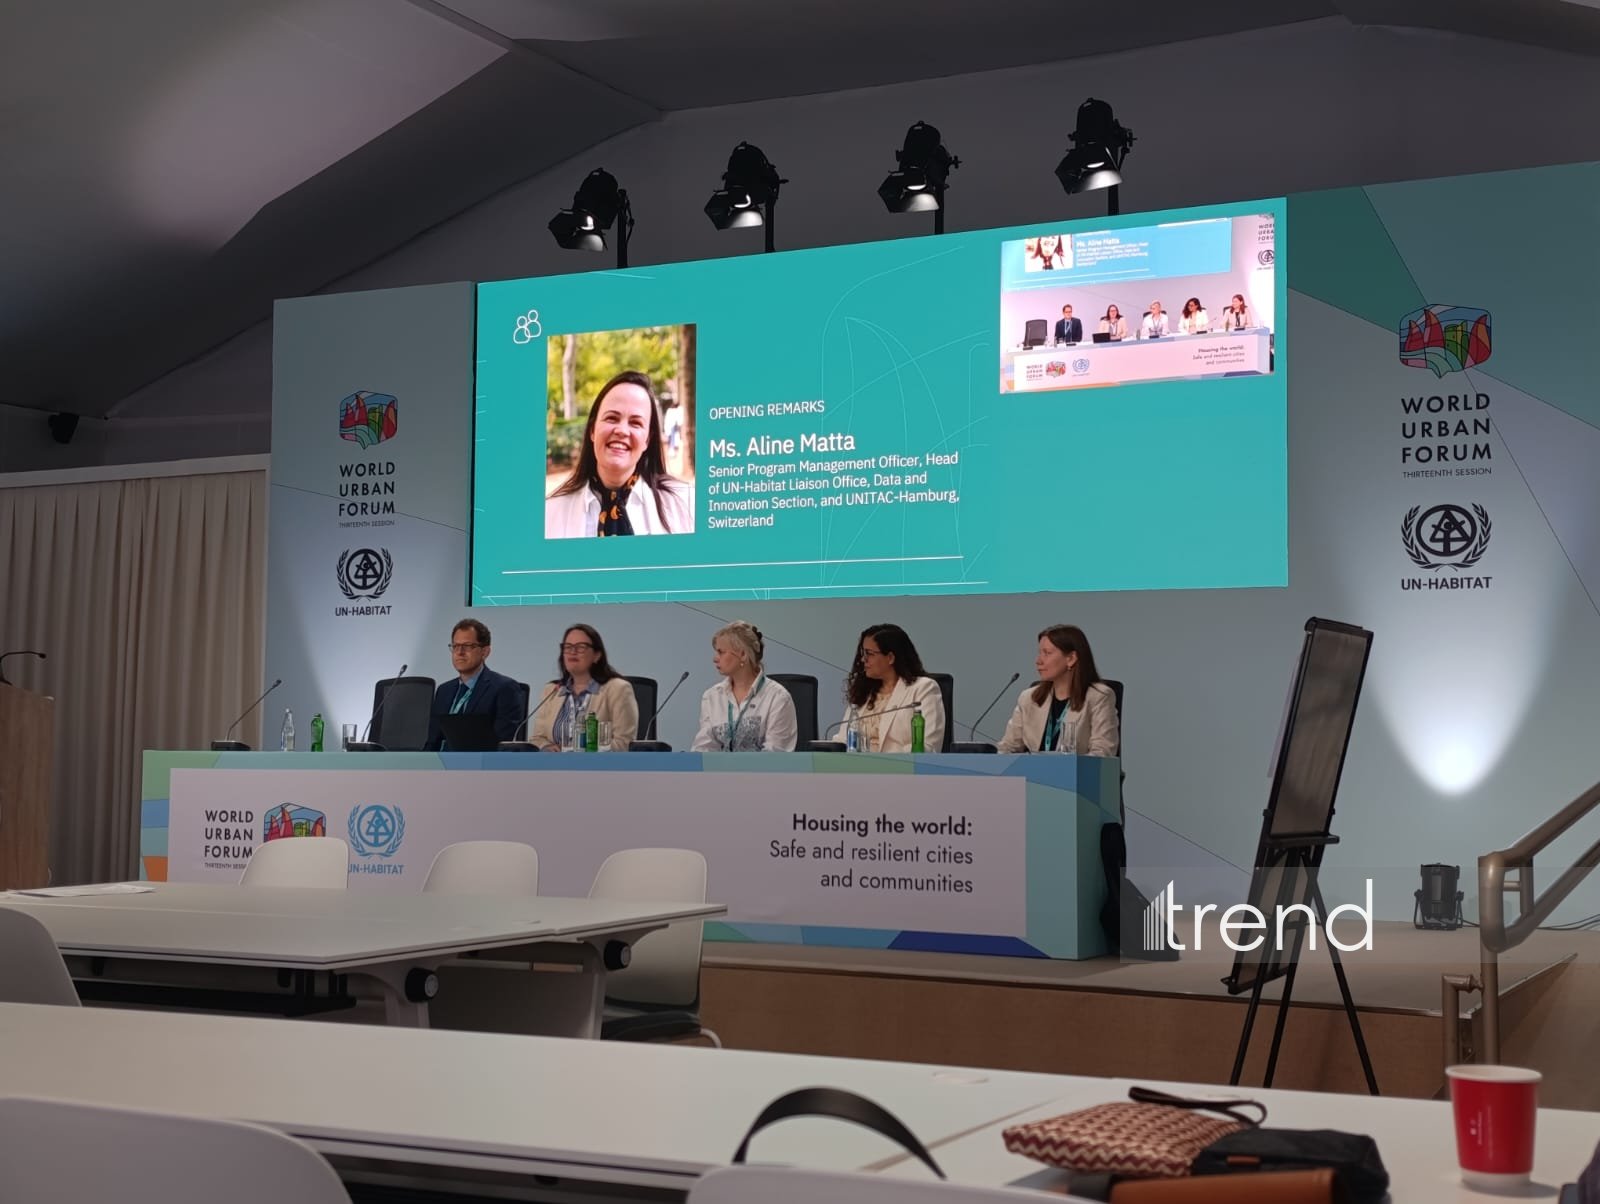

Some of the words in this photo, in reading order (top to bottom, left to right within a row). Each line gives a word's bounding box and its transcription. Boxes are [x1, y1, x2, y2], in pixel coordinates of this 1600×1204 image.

[709, 404, 765, 420] OPENING
[767, 400, 825, 416] REMARKS
[1401, 393, 1490, 414] WORLD
[1402, 418, 1490, 439] URBAN
[709, 439, 741, 459] Ms.
[746, 435, 795, 456] Aline
[799, 432, 856, 453] Matta
[1402, 443, 1492, 464] FORUM
[339, 462, 396, 478] WORLD
[708, 465, 745, 478] Senior
[747, 462, 796, 478] Program
[799, 457, 876, 474] Management
[878, 454, 923, 469] Officer,
[926, 451, 959, 466] Head
[1402, 469, 1453, 479] THIRTEENTH
[1455, 467, 1492, 477] SESSION
[339, 481, 395, 498] URBAN
[708, 482, 721, 495] of
[722, 480, 786, 494] UN-Habitat
[789, 477, 829, 491] Liaison
[832, 474, 871, 489] Office,
[873, 473, 902, 486] Data
[904, 471, 928, 485] and
[338, 501, 395, 517] FORUM
[708, 497, 769, 512] Innovation
[771, 495, 818, 510] Section,
[820, 493, 843, 506] and
[708, 514, 774, 528] Switzerland
[1401, 577, 1493, 590] UN-HABITAT
[335, 605, 393, 617] UN-HABITAT
[204, 809, 254, 823] WORLD
[792, 813, 869, 838] Housing
[875, 813, 905, 833] the
[911, 815, 973, 836] world:
[204, 827, 253, 841] URBAN
[204, 845, 253, 859] FORUM
[770, 838, 806, 859] Safe
[812, 840, 844, 860] and
[851, 841, 920, 863] resilient
[926, 845, 974, 865] cities
[820, 868, 853, 888] and
[859, 873, 974, 893] communities
